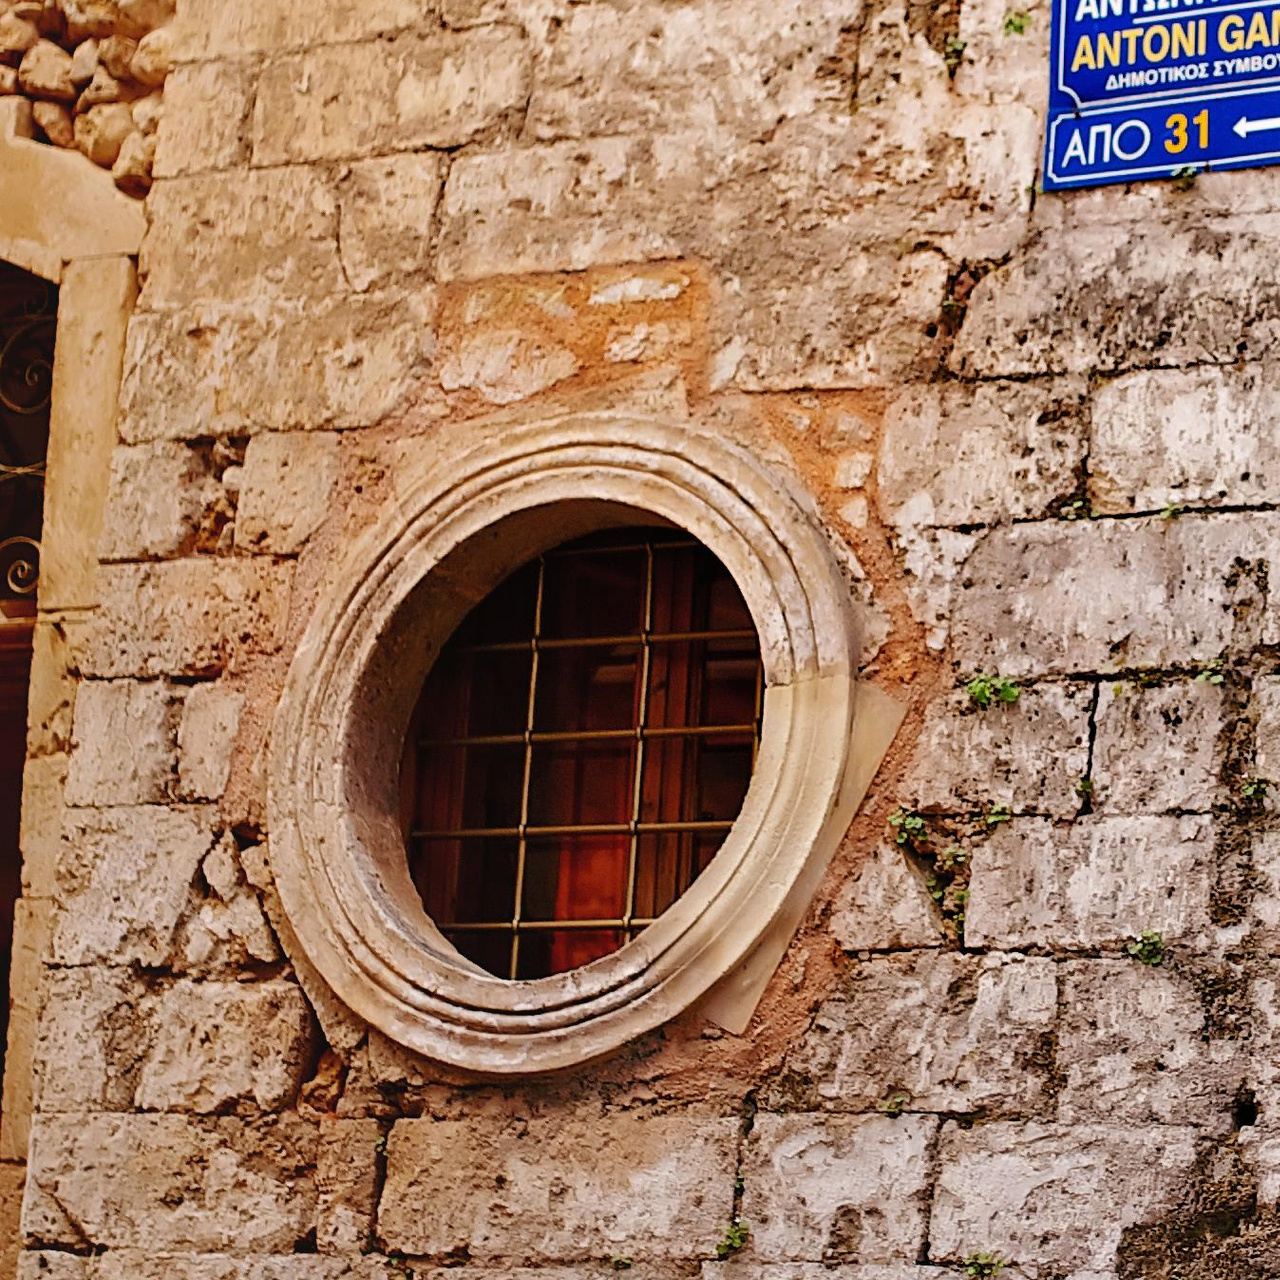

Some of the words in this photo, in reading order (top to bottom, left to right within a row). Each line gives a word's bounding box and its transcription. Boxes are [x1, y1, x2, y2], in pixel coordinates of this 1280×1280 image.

[1070, 18, 1207, 72] ANTONI
[1105, 60, 1209, 91] ΔΗΜΟΤΙΚΟΣ
[1061, 119, 1151, 168] ΑΠΟ
[1163, 109, 1209, 154] 31
